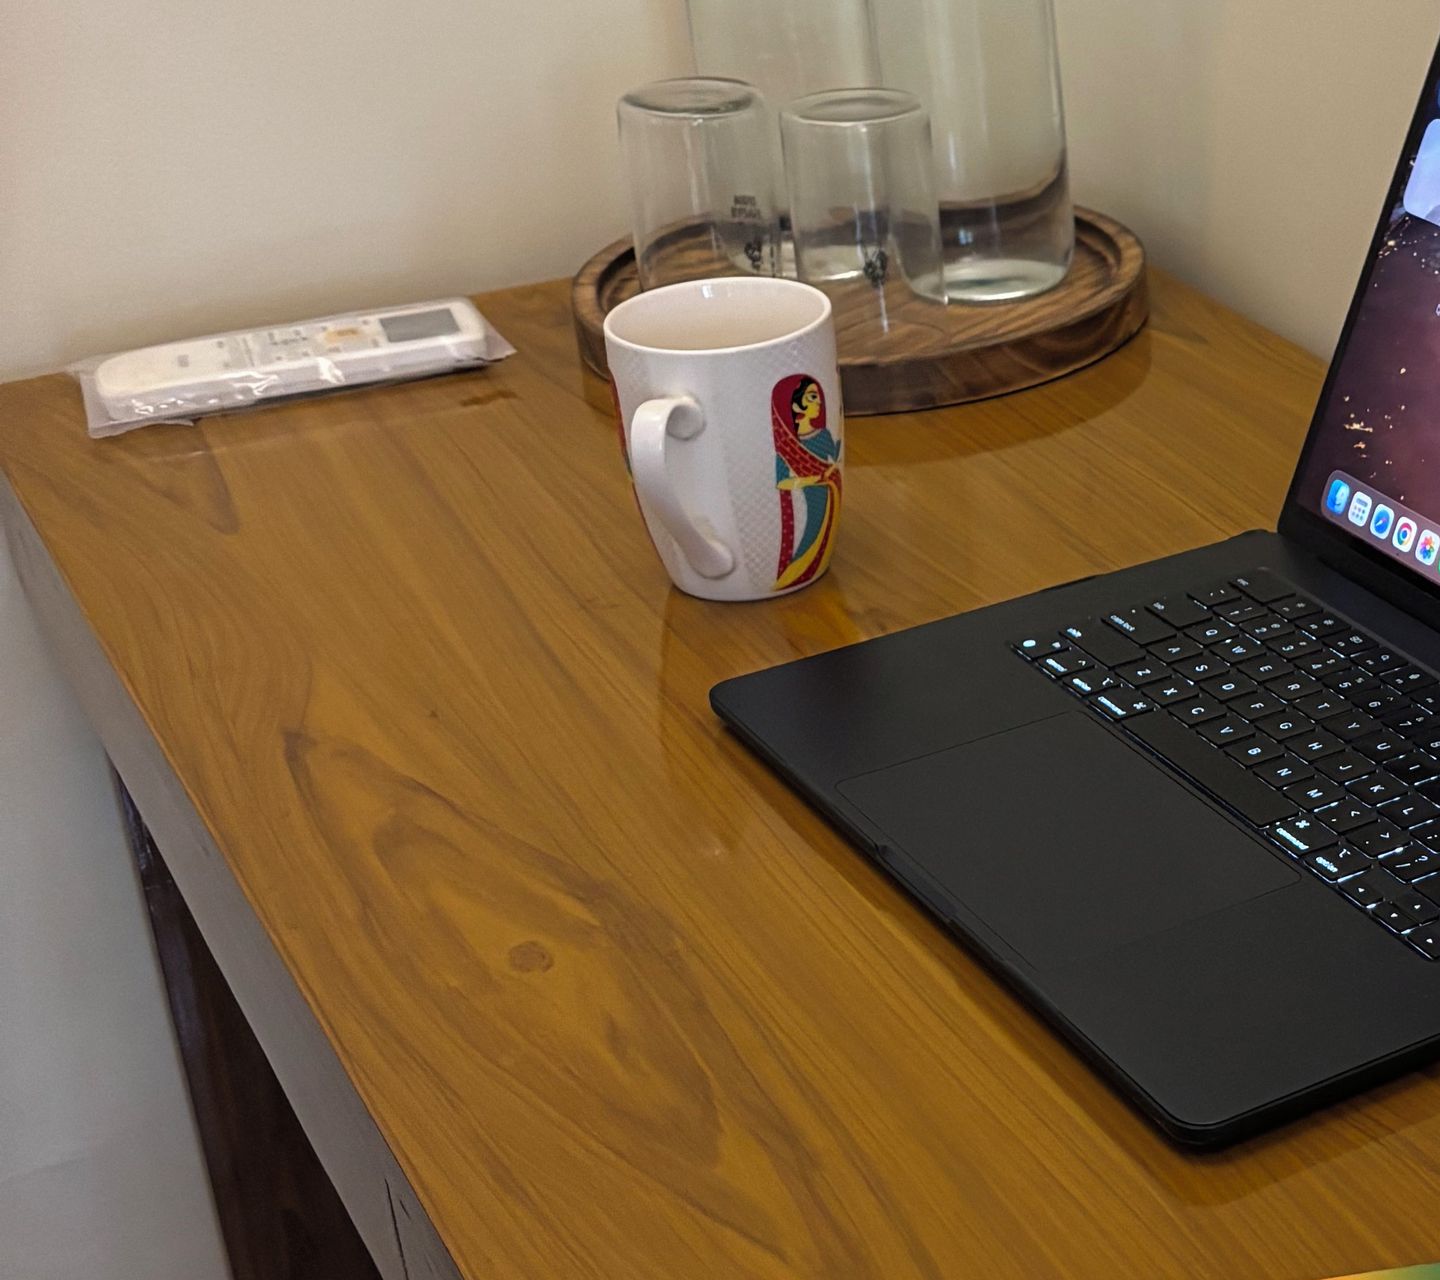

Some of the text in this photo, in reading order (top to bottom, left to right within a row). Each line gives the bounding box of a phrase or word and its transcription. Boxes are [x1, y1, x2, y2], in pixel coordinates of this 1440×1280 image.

[1136, 668, 1150, 676] Z
[1163, 687, 1177, 695] X
[1276, 768, 1291, 776] N
[1306, 788, 1322, 797] M
[1231, 645, 1246, 653] W
[1376, 742, 1390, 750] U
[1276, 827, 1337, 872] command option
